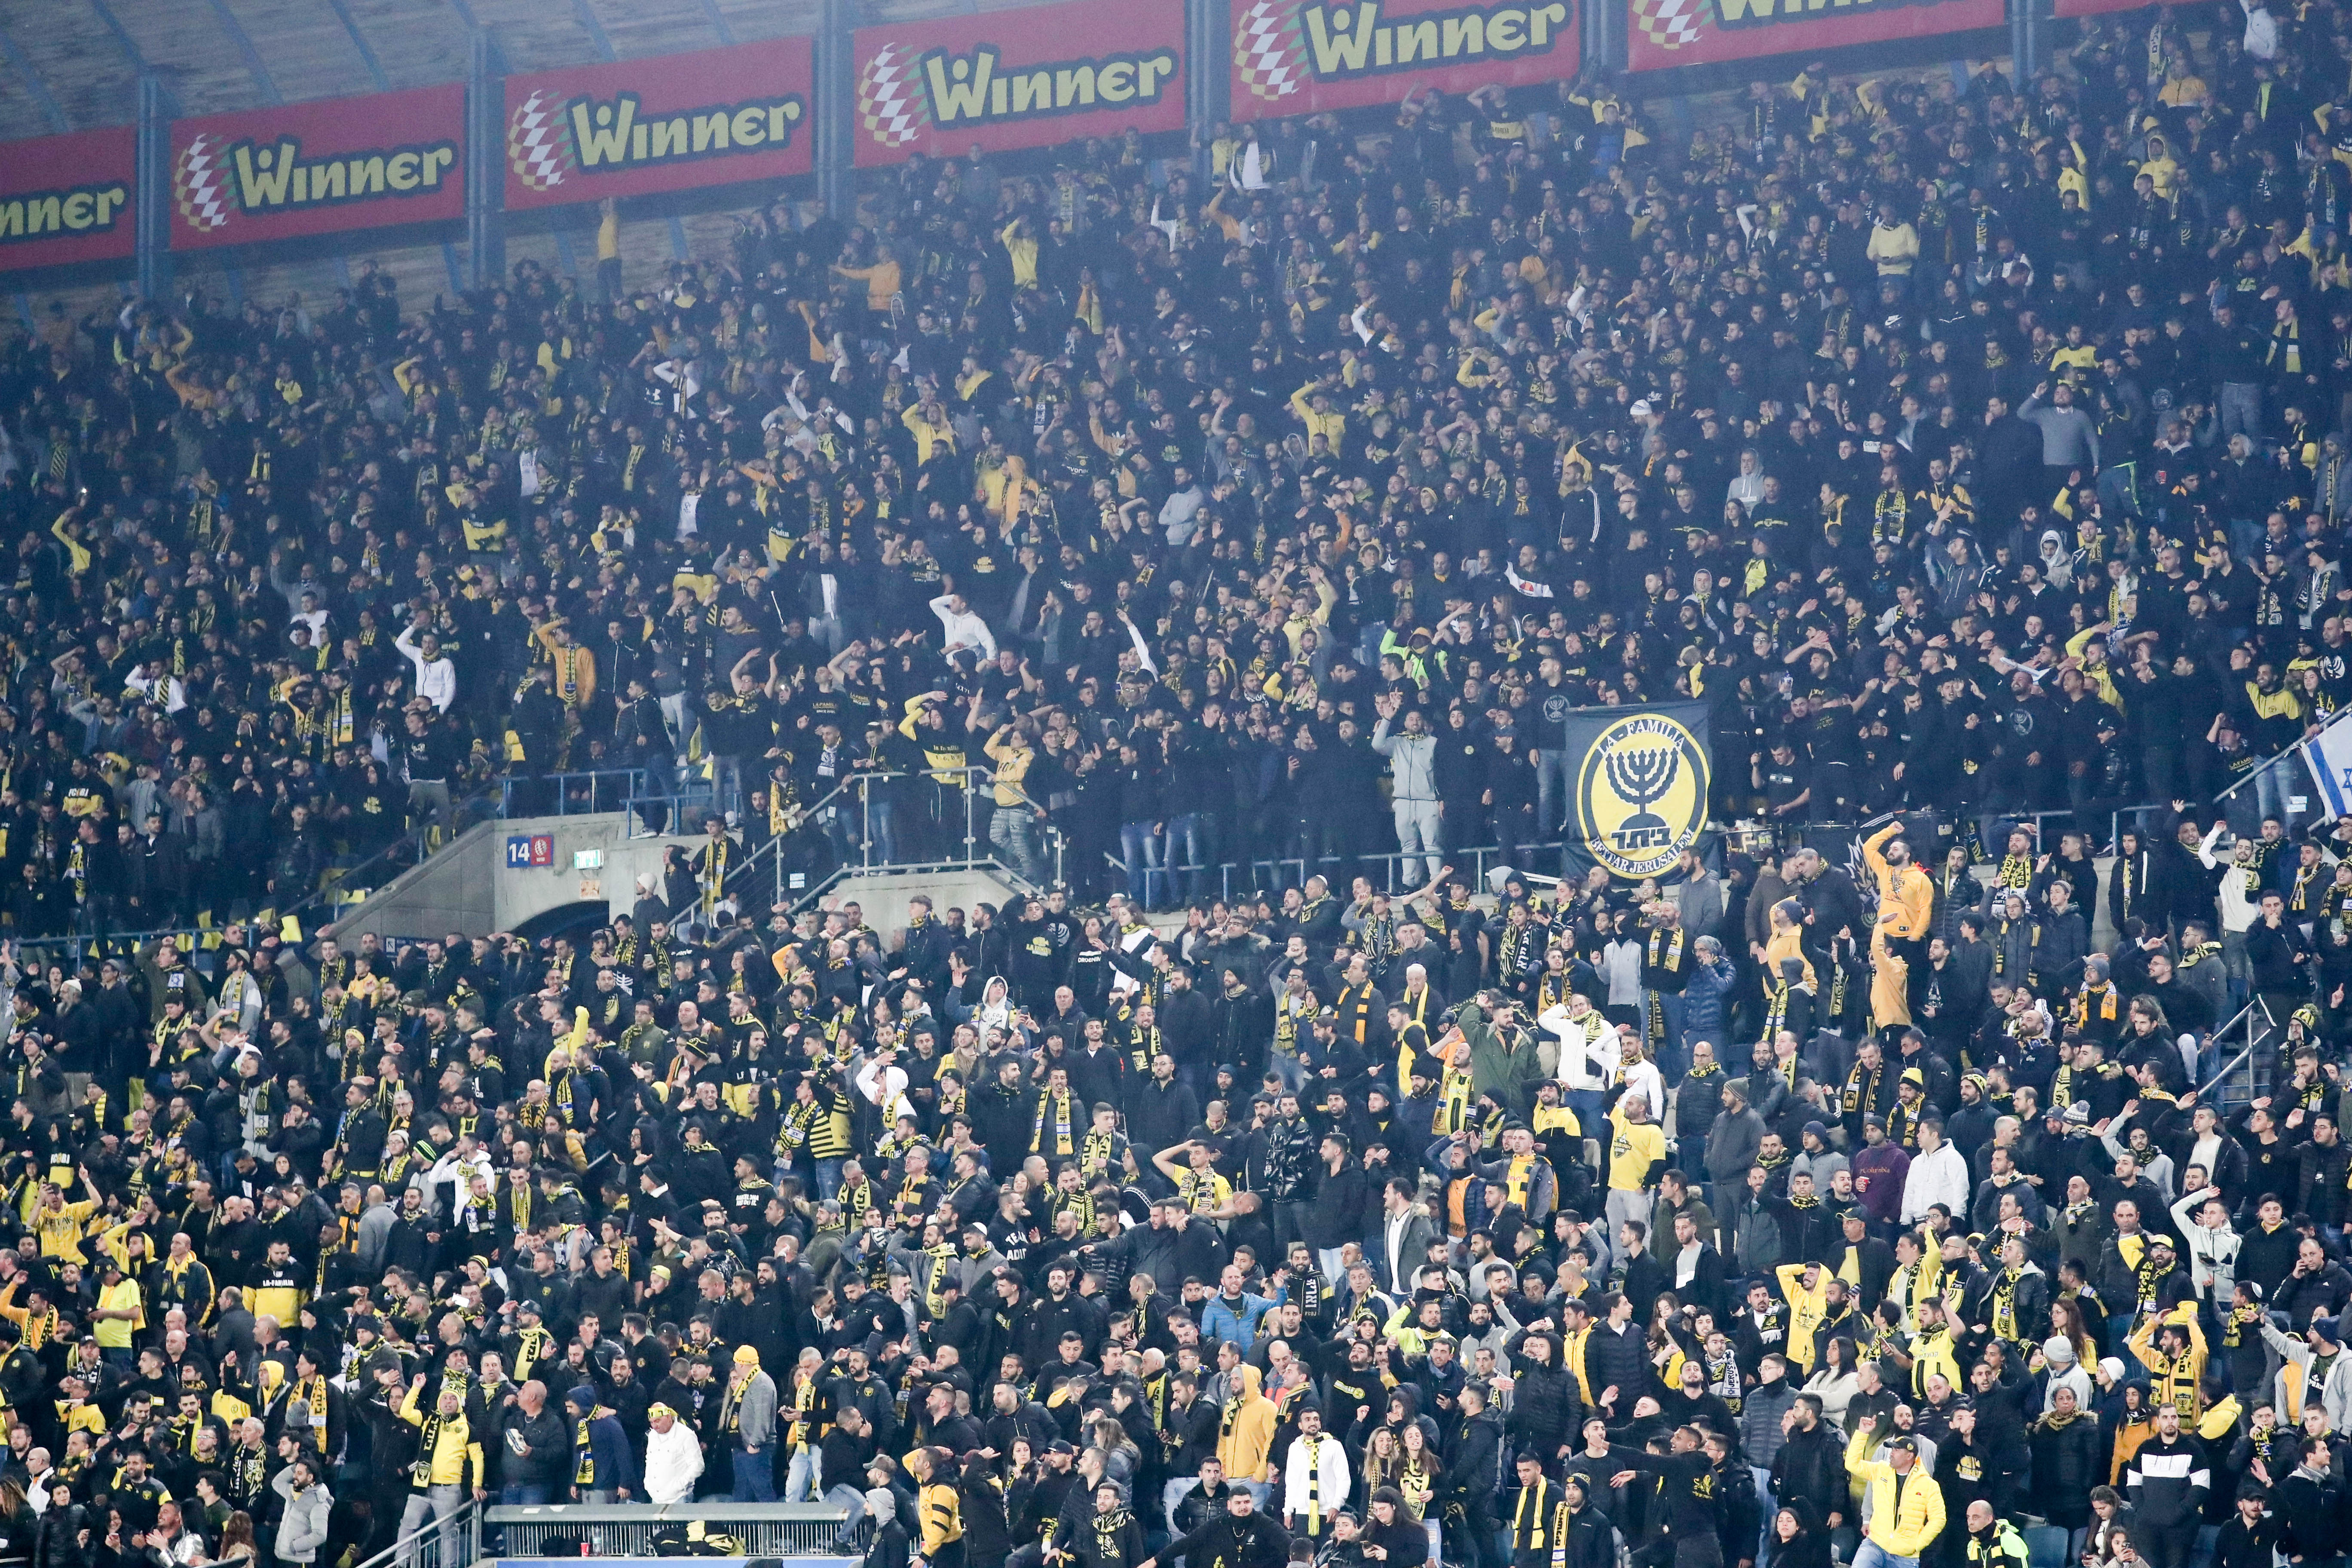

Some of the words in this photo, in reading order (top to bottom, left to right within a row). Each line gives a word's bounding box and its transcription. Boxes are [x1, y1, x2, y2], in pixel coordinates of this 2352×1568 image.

[1306, 2, 1566, 74] Winner
[927, 52, 1173, 122] Winner
[572, 101, 800, 165] Winner
[236, 142, 453, 208] Winner
[0, 188, 125, 236] nner
[1596, 735, 1614, 756] LA
[1625, 719, 1686, 751] FAMILIA
[509, 843, 530, 862] 14
[1611, 827, 1672, 850] ביתר
[1629, 827, 1695, 874] JERUSALEM
